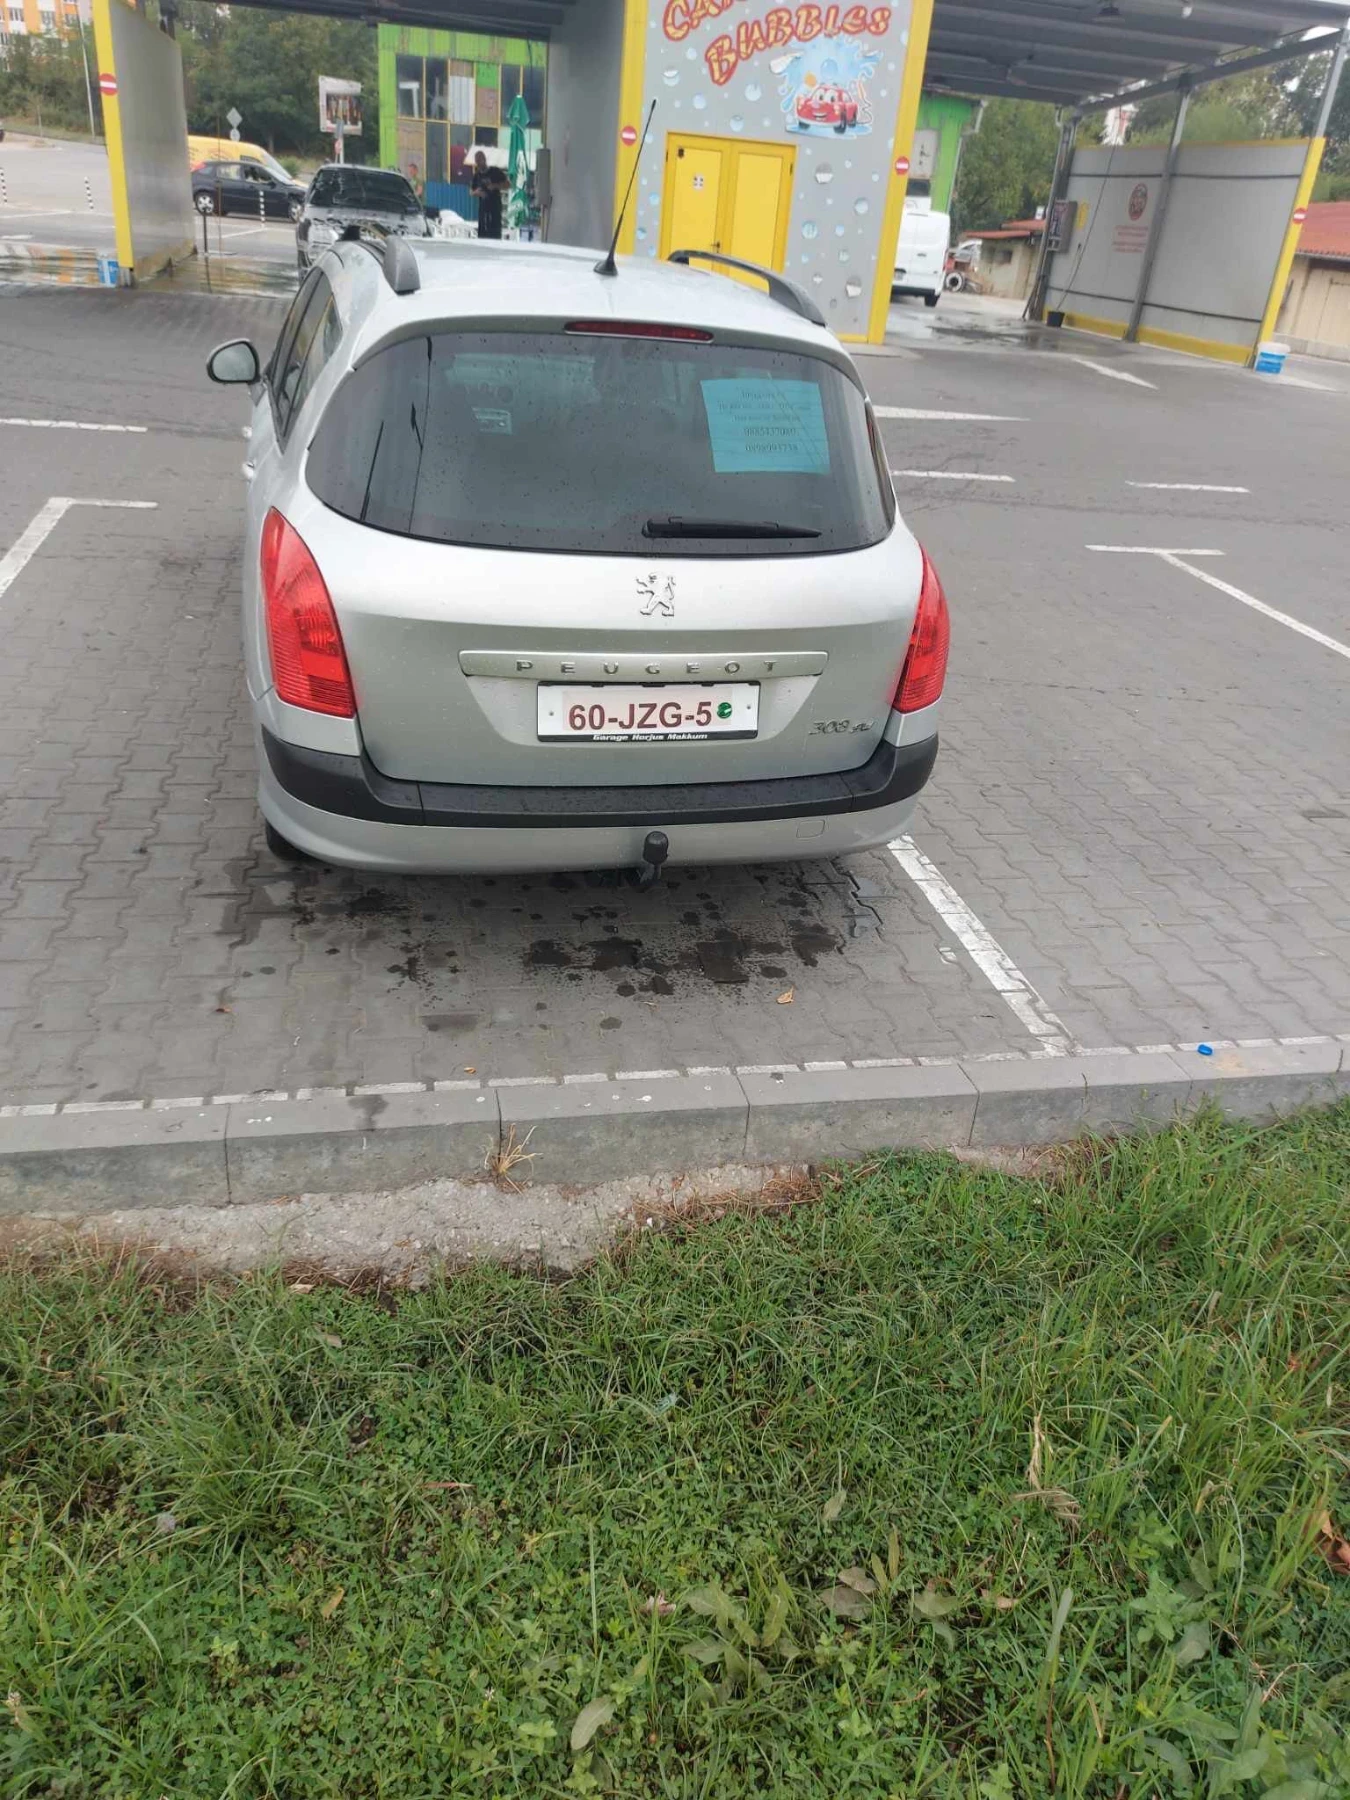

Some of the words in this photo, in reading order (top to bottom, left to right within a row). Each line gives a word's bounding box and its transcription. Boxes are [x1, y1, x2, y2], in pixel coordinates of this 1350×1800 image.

[663, 0, 744, 42] CA
[516, 659, 777, 675] PEUGEOT
[568, 701, 712, 731] 60-JZG-5
